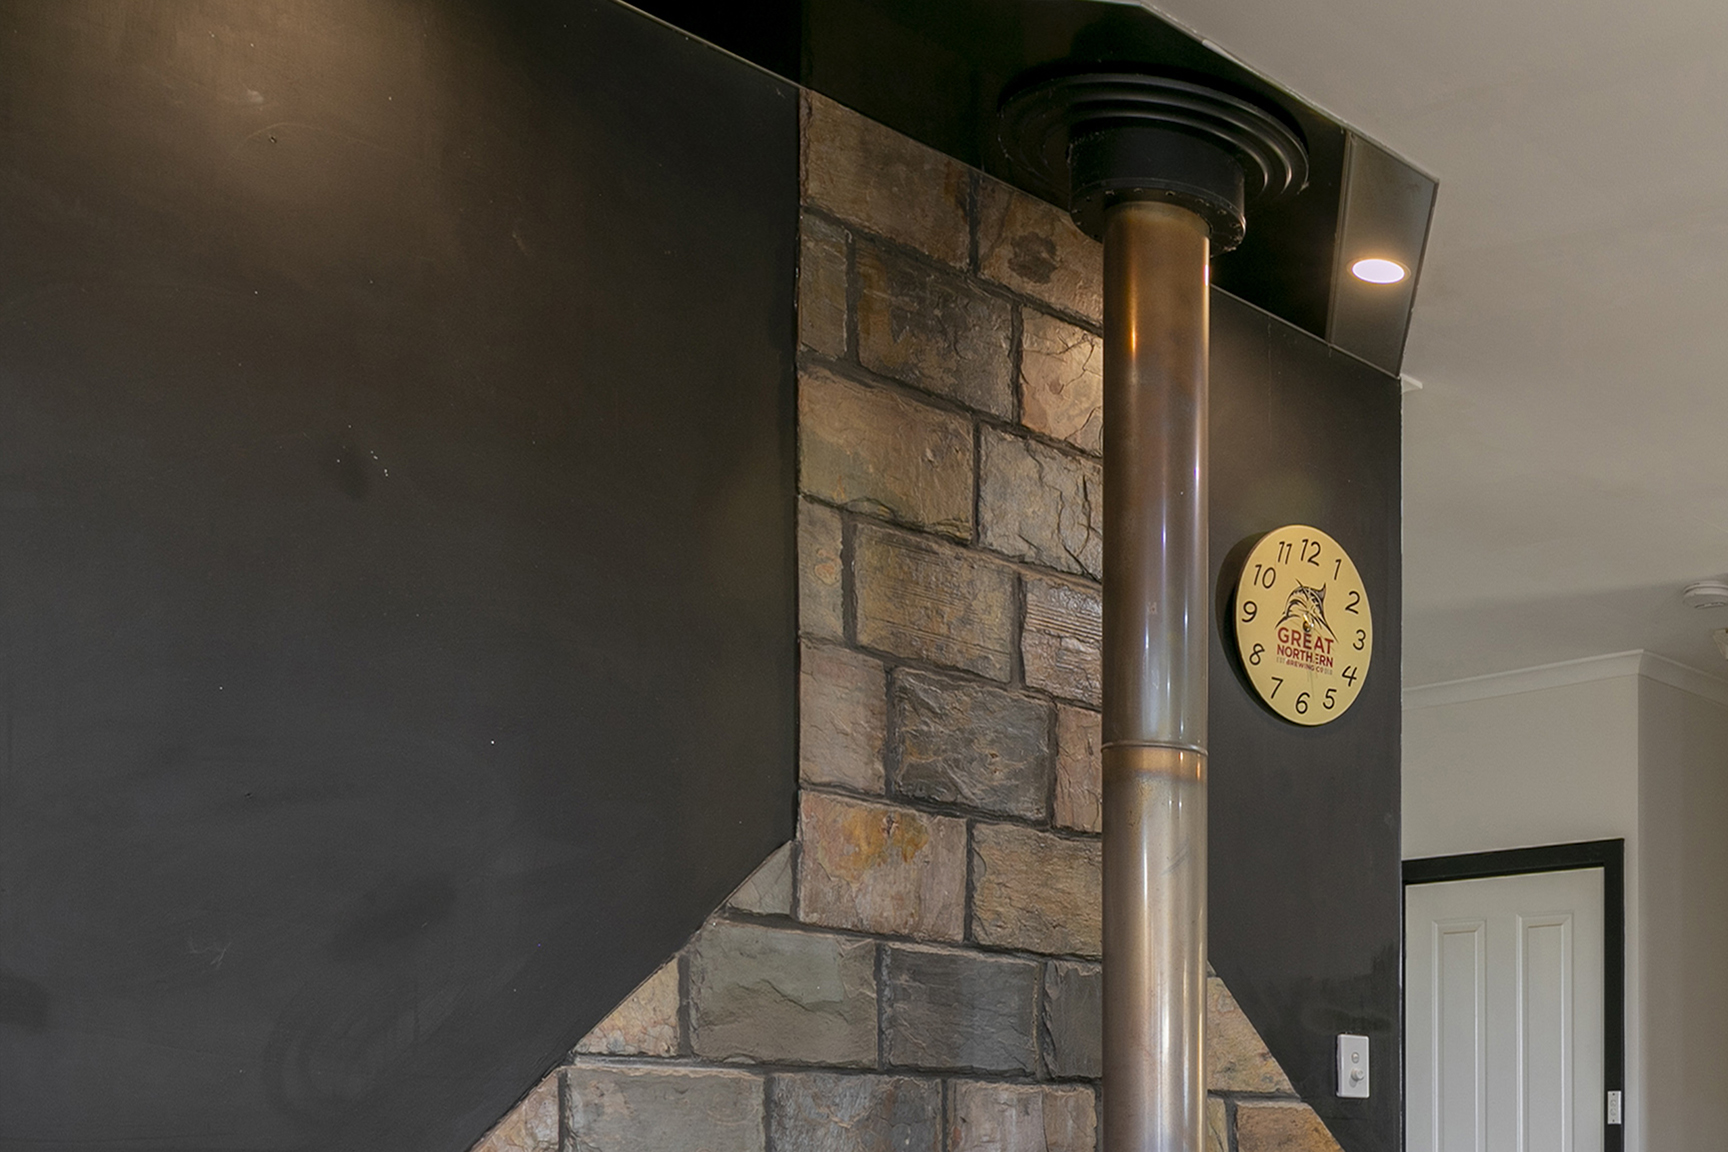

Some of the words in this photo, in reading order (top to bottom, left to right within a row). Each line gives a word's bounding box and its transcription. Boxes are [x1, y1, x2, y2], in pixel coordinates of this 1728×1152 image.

[1277, 541, 1293, 565] 11
[1300, 538, 1322, 567] 12
[1253, 564, 1277, 589] 10
[1333, 558, 1342, 580] 1
[1241, 600, 1258, 623] 9
[1345, 590, 1361, 615] 2
[1277, 627, 1334, 655] GREAT
[1353, 629, 1366, 651] 3
[1249, 643, 1265, 666] 8
[1276, 643, 1334, 668] NORTHERN
[1286, 659, 1315, 671] BREWING
[1271, 676, 1284, 699] 7
[1342, 665, 1358, 687] 4
[1295, 692, 1310, 714] 6
[1322, 688, 1337, 710] 5
